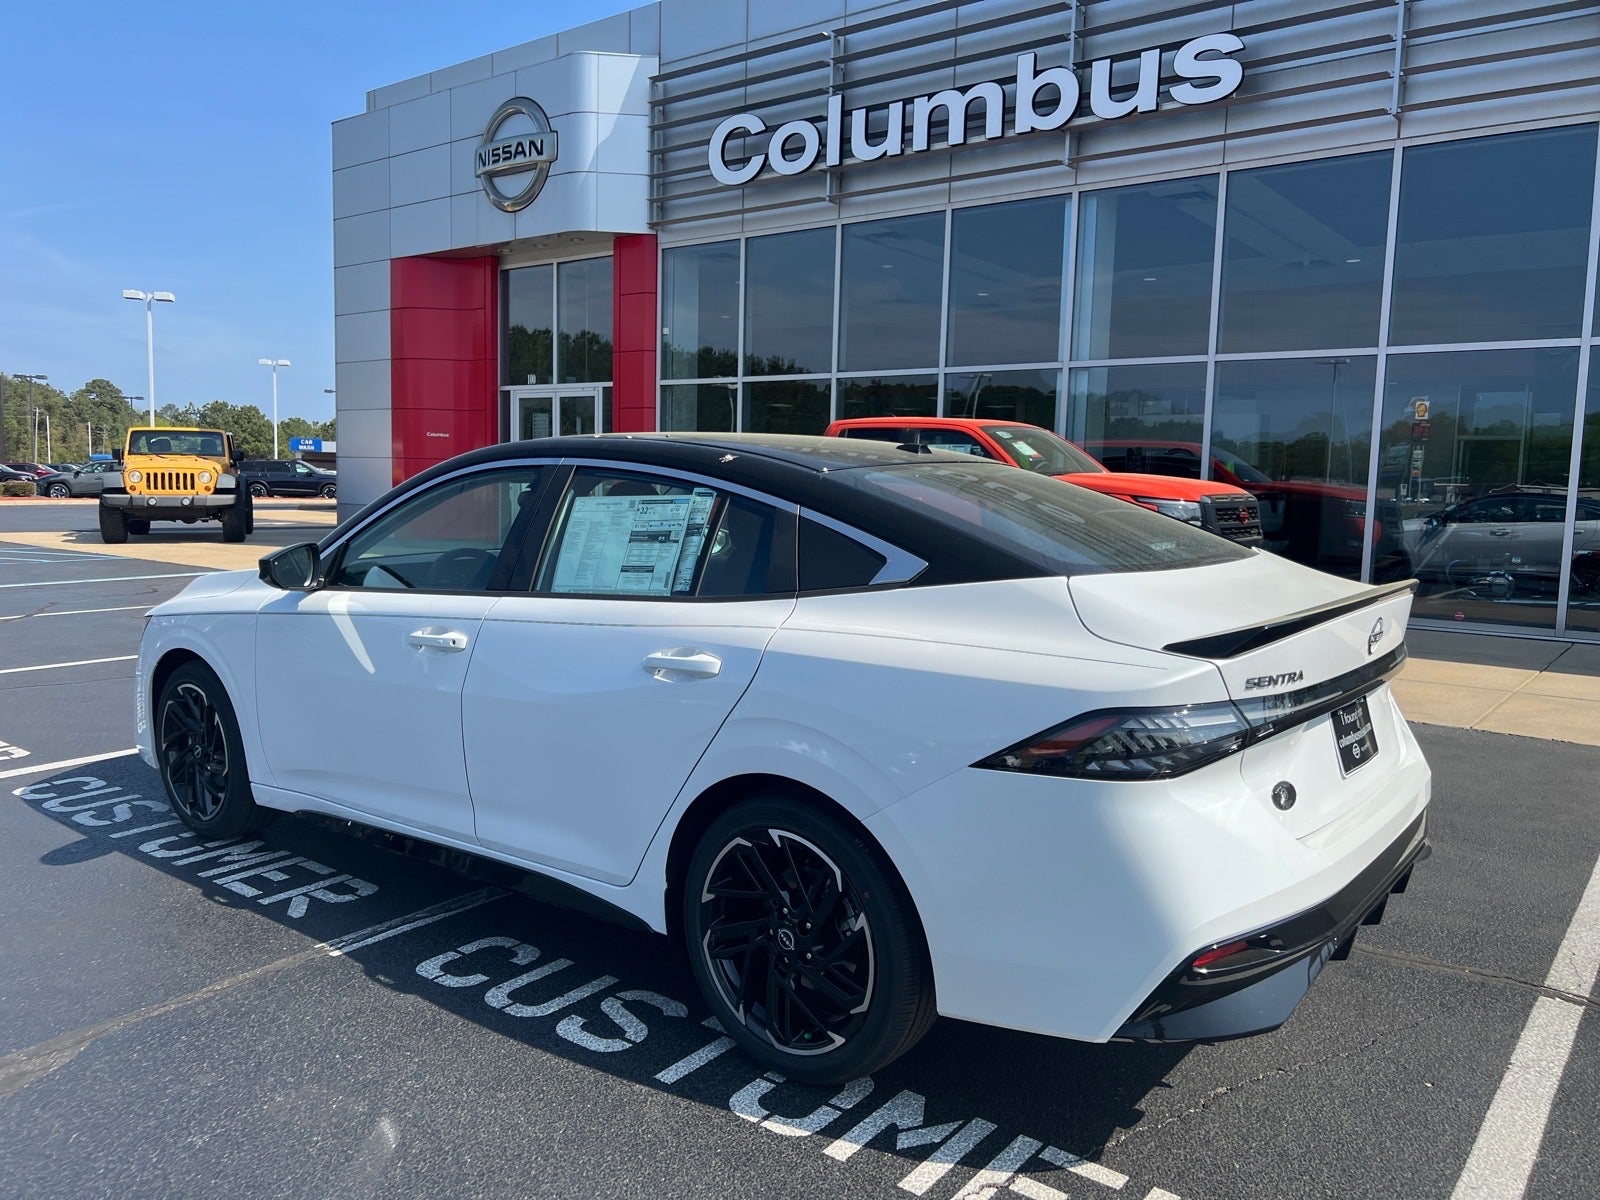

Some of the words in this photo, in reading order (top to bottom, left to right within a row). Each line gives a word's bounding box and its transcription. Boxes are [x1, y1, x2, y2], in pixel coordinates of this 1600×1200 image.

[707, 32, 1246, 187] Columbus
[478, 139, 544, 169] NISSAN
[527, 374, 537, 384] 100
[1245, 670, 1304, 690] SENTRA
[415, 936, 1182, 1200] CUSTOME
